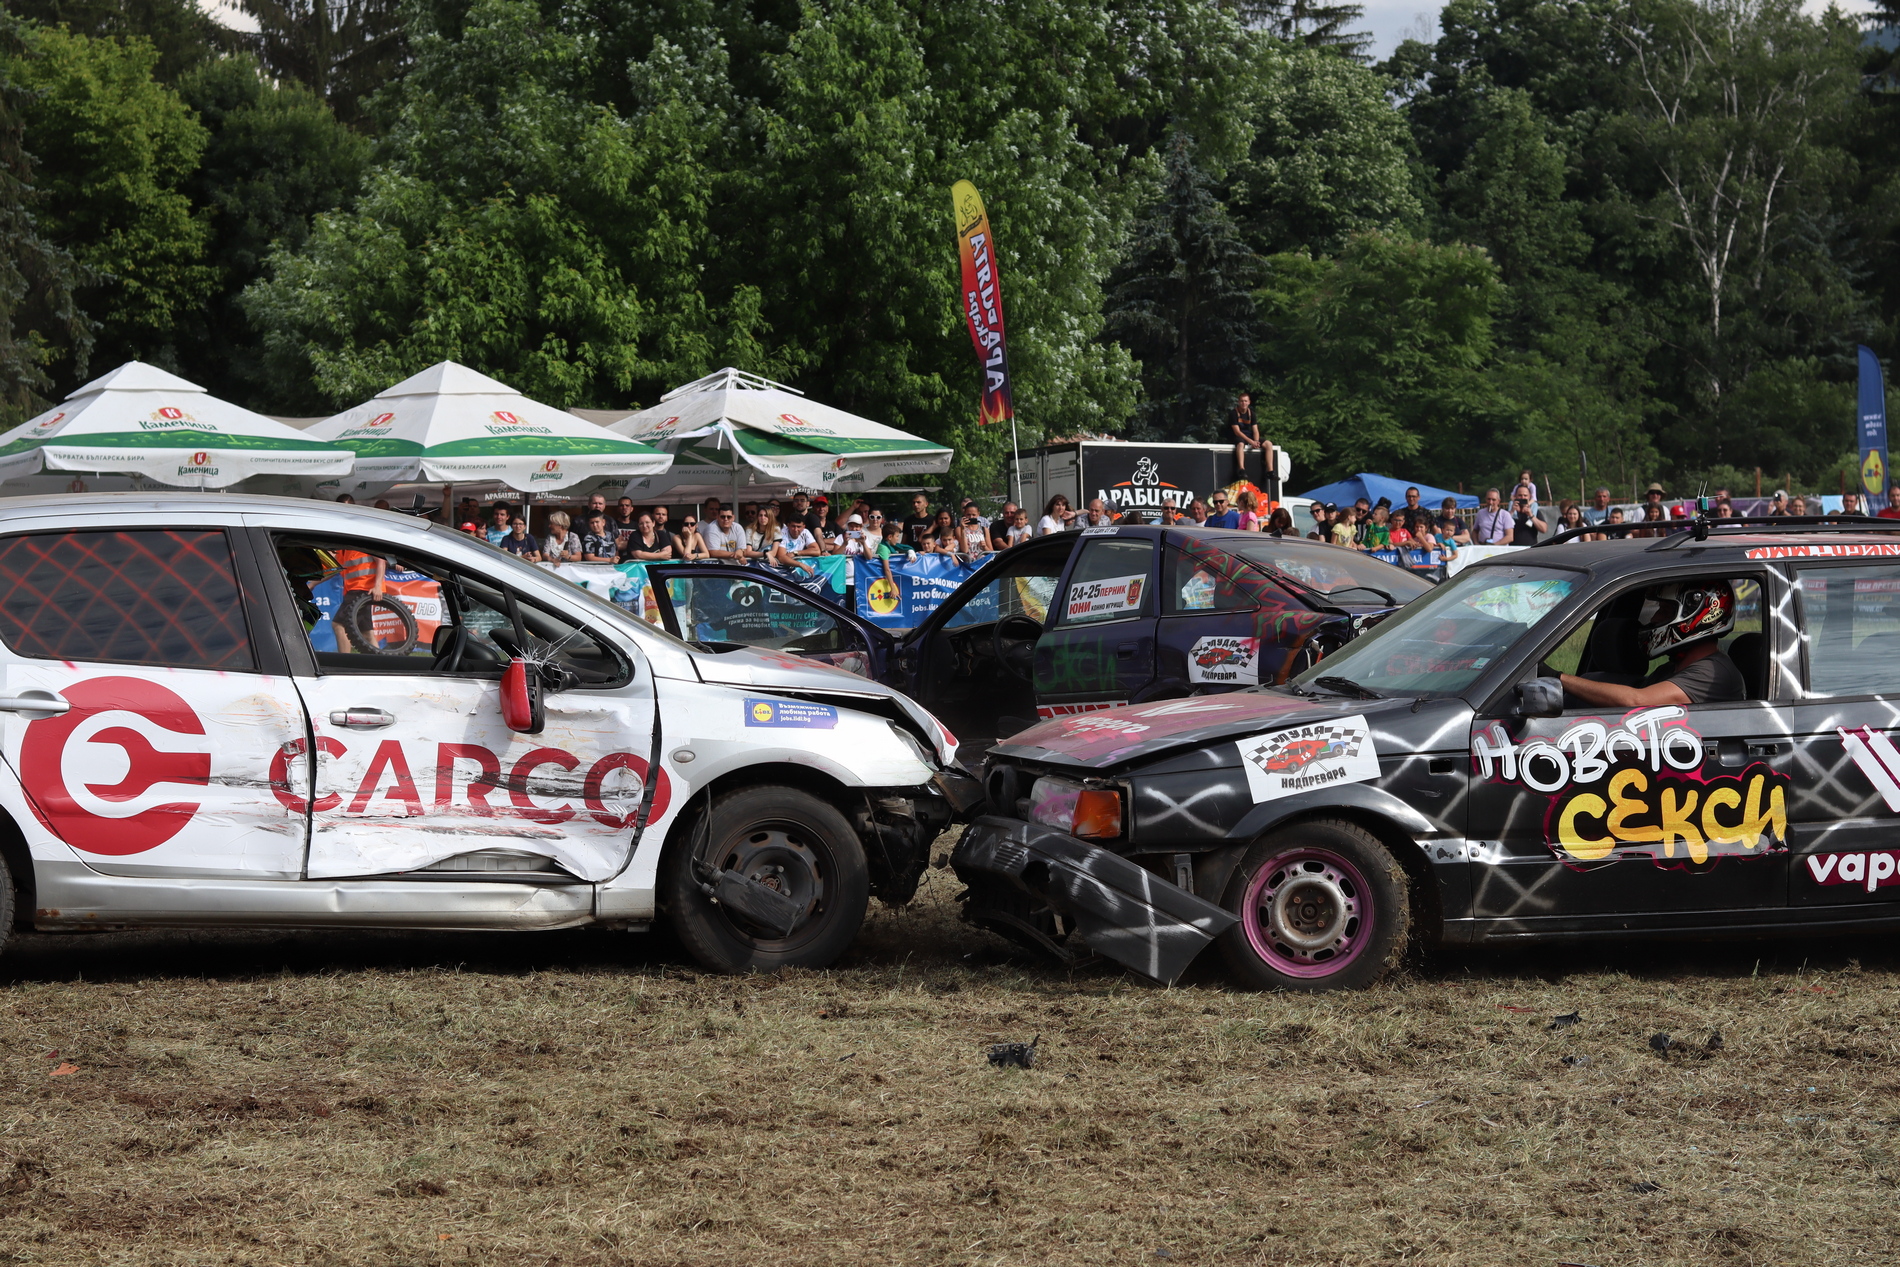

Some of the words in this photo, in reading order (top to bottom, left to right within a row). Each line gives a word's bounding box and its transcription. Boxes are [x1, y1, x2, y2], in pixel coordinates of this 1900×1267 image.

[138, 420, 219, 431] Каменица
[484, 424, 553, 435] Каменица
[53, 453, 84, 461] ПЪРВАТА
[86, 453, 125, 461] БЪЛГАРСКА
[177, 465, 219, 476] Каменица
[529, 471, 563, 483] Каменица
[1070, 583, 1102, 602] 24-25
[1100, 584, 1127, 597] ПЕРНИК
[315, 596, 331, 606] за
[416, 602, 437, 616] HD
[1069, 601, 1092, 615] ЮНИ
[1091, 603, 1106, 611] КОННО
[1105, 601, 1124, 610] ИГРИЩЕ
[803, 611, 818, 619] CARE
[1703, 610, 1723, 623] VEMAR
[1210, 638, 1237, 648] ЛУДА
[1201, 669, 1237, 681] НАДПРЕВАРА
[778, 703, 820, 711] Възможност
[779, 708, 807, 716] любима
[807, 709, 831, 717] работа
[780, 715, 811, 723] jobs.lidl.bg
[1278, 725, 1325, 743] ЛУДА
[1300, 750, 1311, 762] 14
[268, 736, 671, 831] CARCO
[1281, 766, 1347, 790] НАДПРЕВАРА
[1557, 767, 1788, 865] СЕКСИ
[1806, 852, 1900, 893] vap
